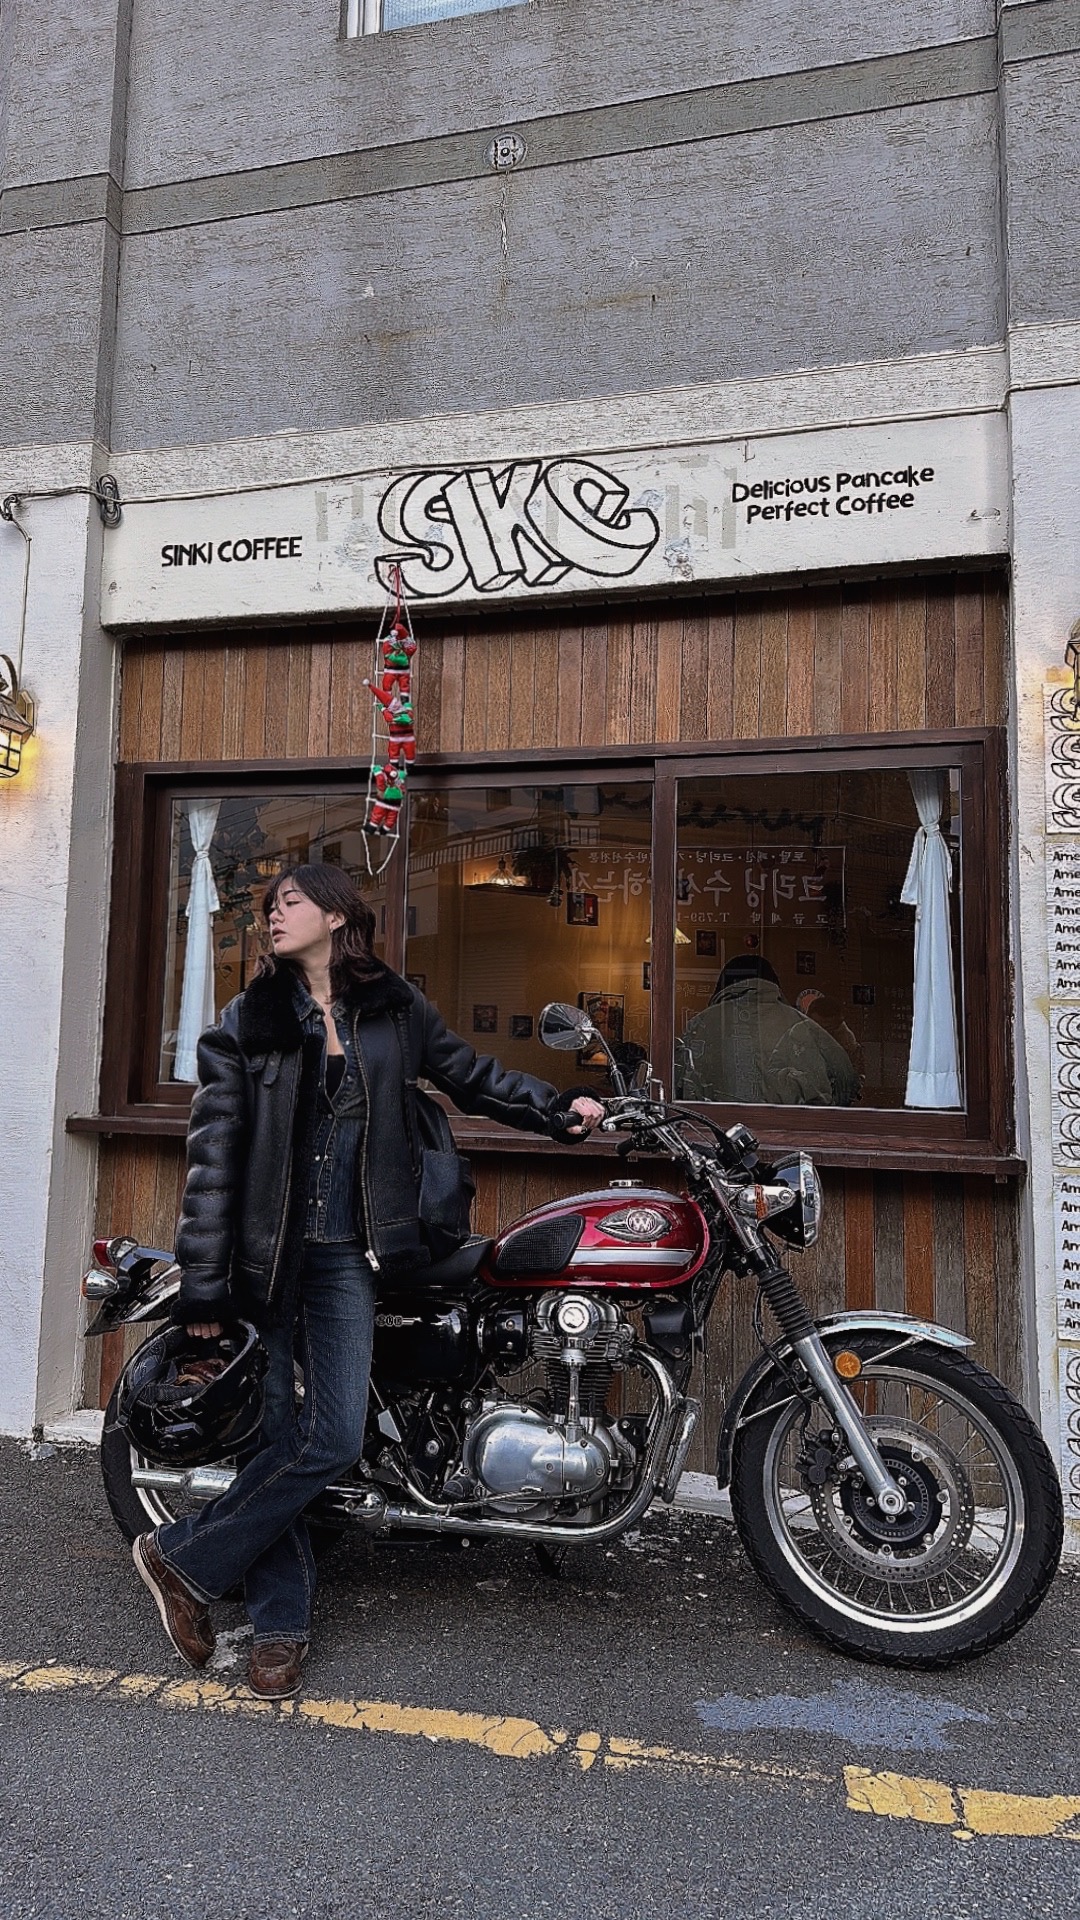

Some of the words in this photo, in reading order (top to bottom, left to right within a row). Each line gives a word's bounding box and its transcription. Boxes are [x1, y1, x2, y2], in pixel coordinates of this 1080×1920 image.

[732, 475, 831, 503] Delicious
[836, 465, 935, 493] Pancake
[747, 498, 829, 524] Perfect
[836, 492, 915, 514] Coffee
[161, 542, 213, 567] SINKI
[218, 535, 303, 562] COFFEE
